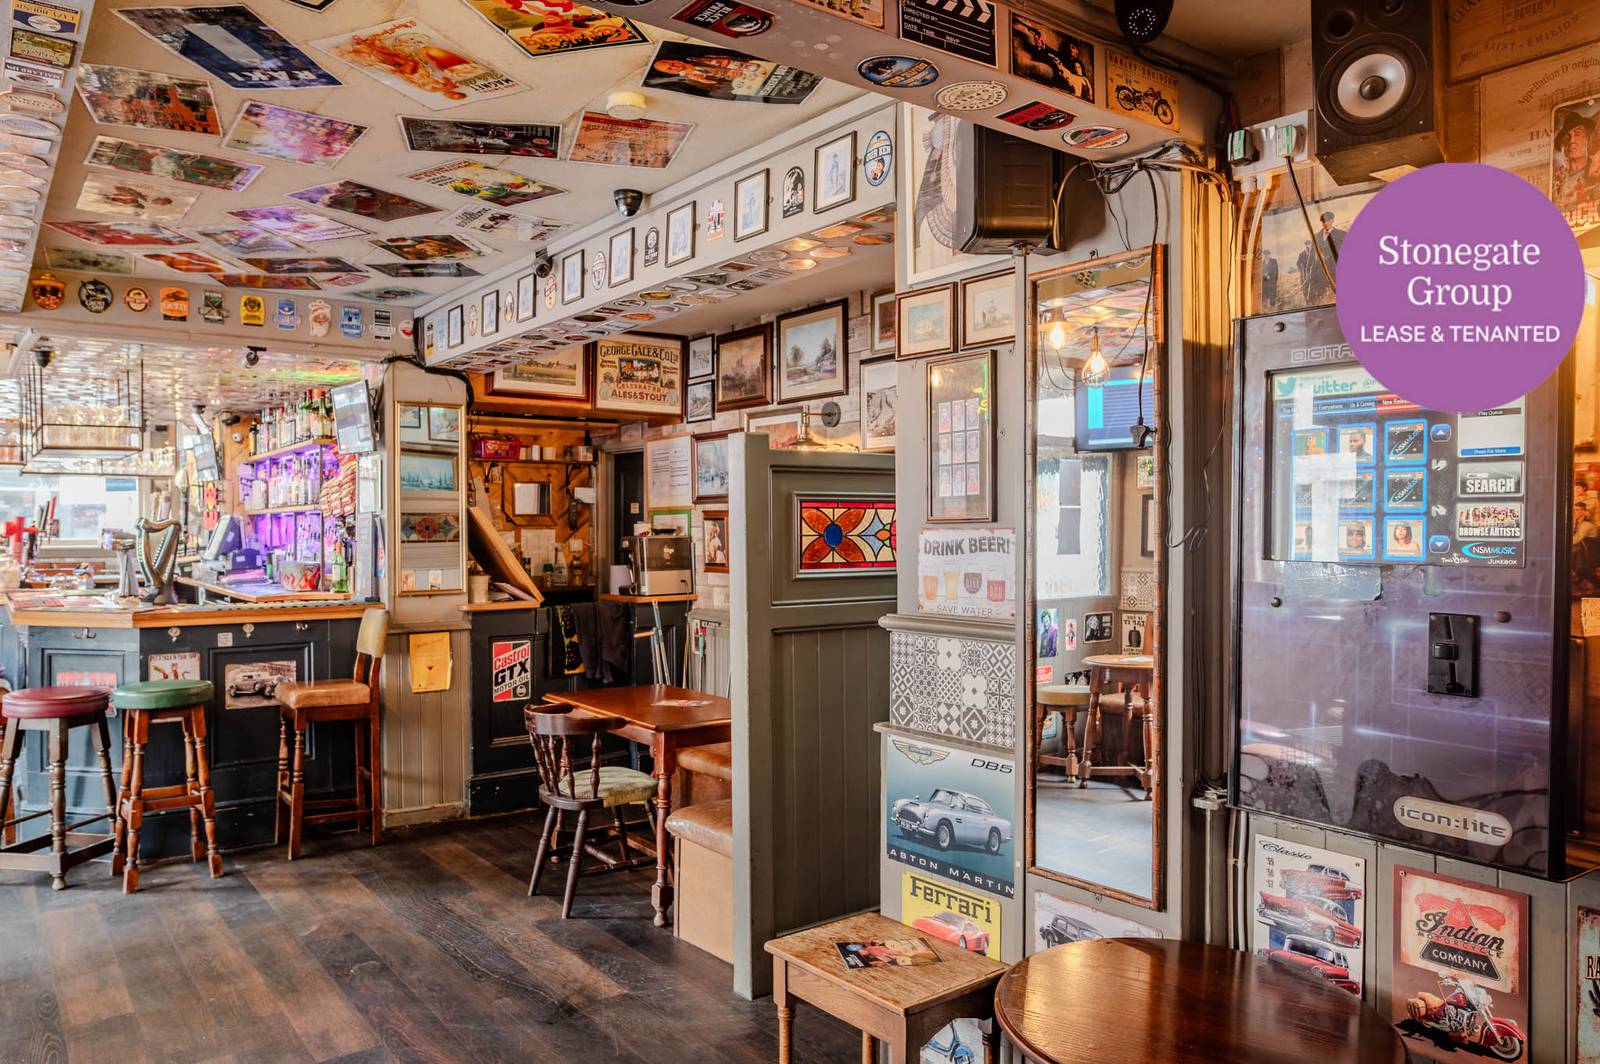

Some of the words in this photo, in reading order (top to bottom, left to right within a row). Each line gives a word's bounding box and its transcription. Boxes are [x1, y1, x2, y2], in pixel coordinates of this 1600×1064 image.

[693, 2, 727, 22] PRINCE
[706, 5, 734, 24] BLACK
[903, 6, 930, 21] DIRECTED
[930, 14, 939, 22] BY
[903, 14, 923, 25] SCENE
[903, 21, 918, 31] DATE
[469, 78, 514, 92] MAGNET
[600, 345, 631, 358] GEORGE
[631, 345, 653, 359] GALE
[610, 389, 633, 399] ALES
[638, 391, 668, 402] STOUT
[1466, 478, 1515, 494] SEARCH
[1459, 527, 1489, 537] BROWSE
[1490, 526, 1520, 537] ARTISTS
[923, 537, 966, 557] DRINK
[968, 535, 1011, 555] BEER!
[936, 604, 959, 615] SAVE
[961, 606, 995, 617] WATER
[493, 644, 531, 671] Castrol
[494, 658, 530, 687] GTX
[493, 680, 518, 694] MOTOR
[518, 675, 530, 686] OIL
[970, 757, 1013, 774] DB5
[889, 847, 939, 870] ASTON
[948, 866, 1015, 895] MARTIN
[910, 875, 992, 923] Ferrari
[1415, 911, 1505, 952] Indian
[1416, 931, 1503, 960] MOTORCYCLE
[1432, 948, 1488, 972] COMPANY
